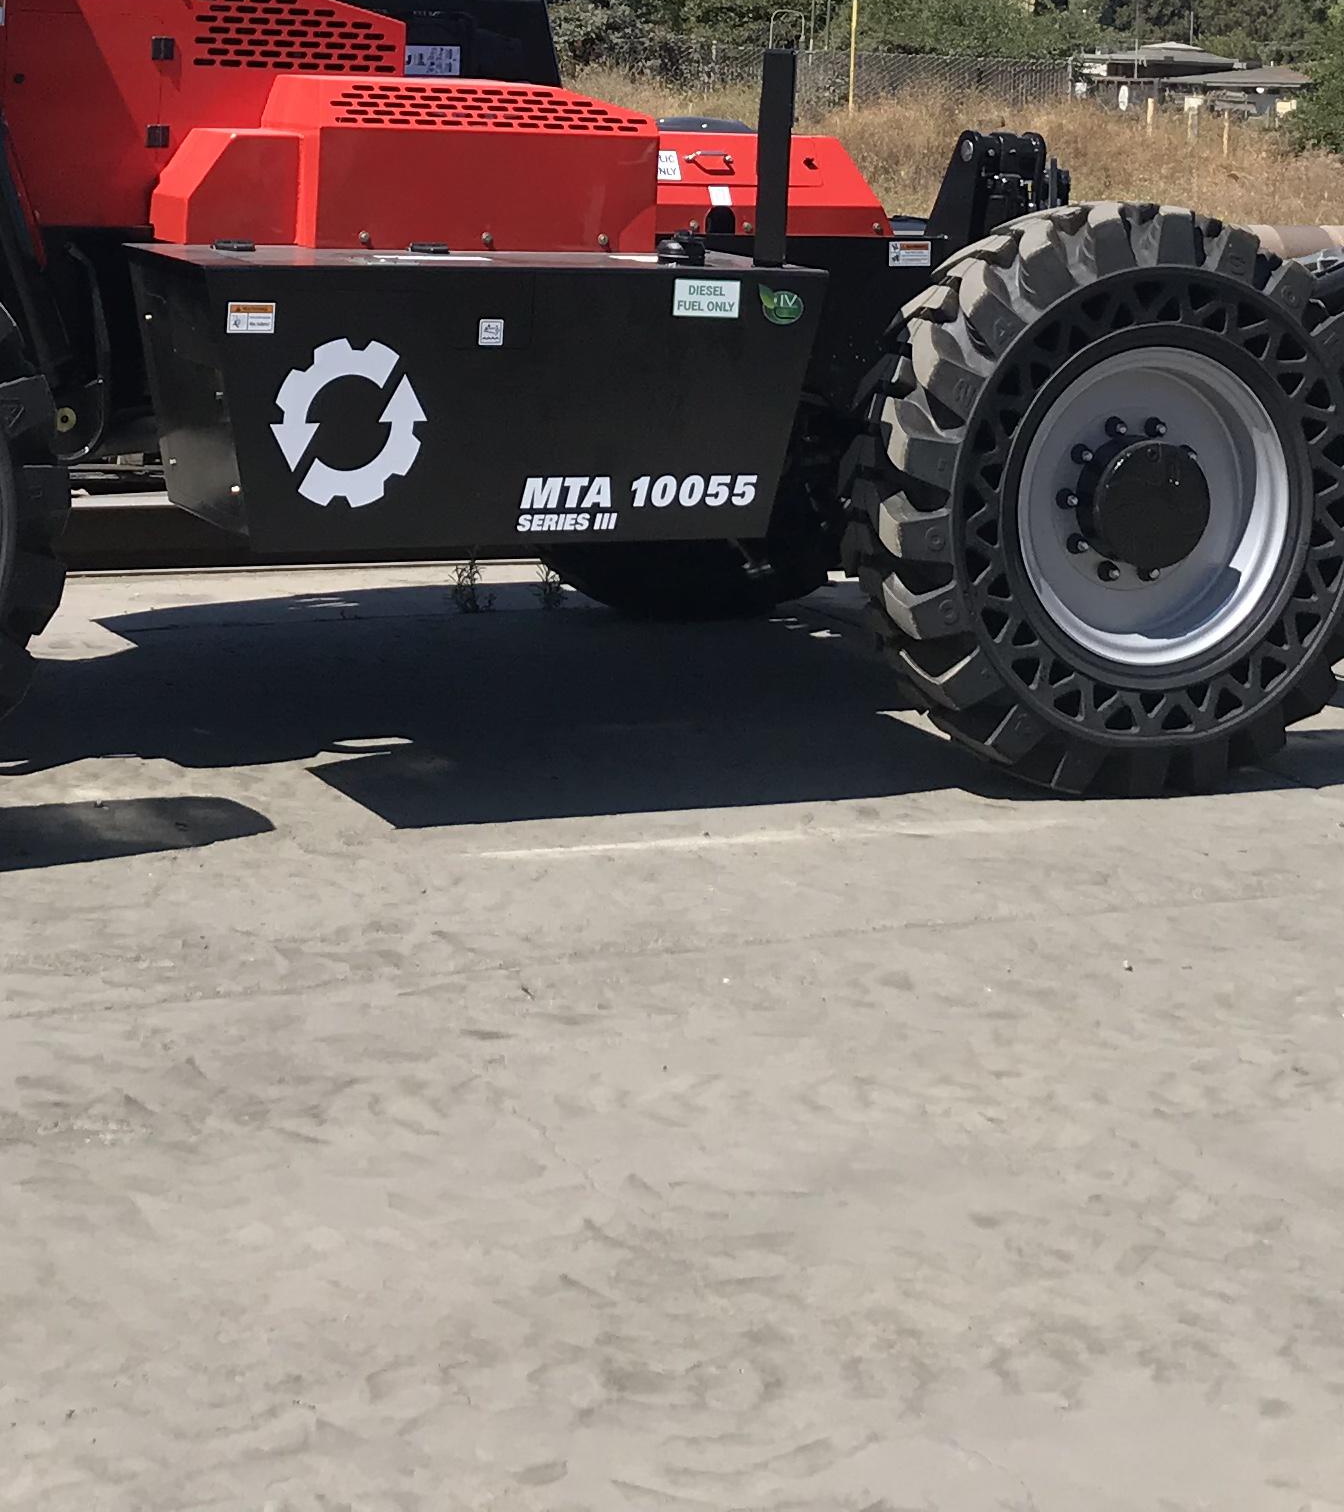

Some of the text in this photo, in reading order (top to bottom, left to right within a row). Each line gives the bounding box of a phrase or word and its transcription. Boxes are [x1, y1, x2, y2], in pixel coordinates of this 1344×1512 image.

[688, 285, 726, 297] DIESEL
[677, 300, 735, 312] FUEL ONLY
[520, 475, 758, 509] MTA 10055
[516, 512, 618, 532] SERIES III
